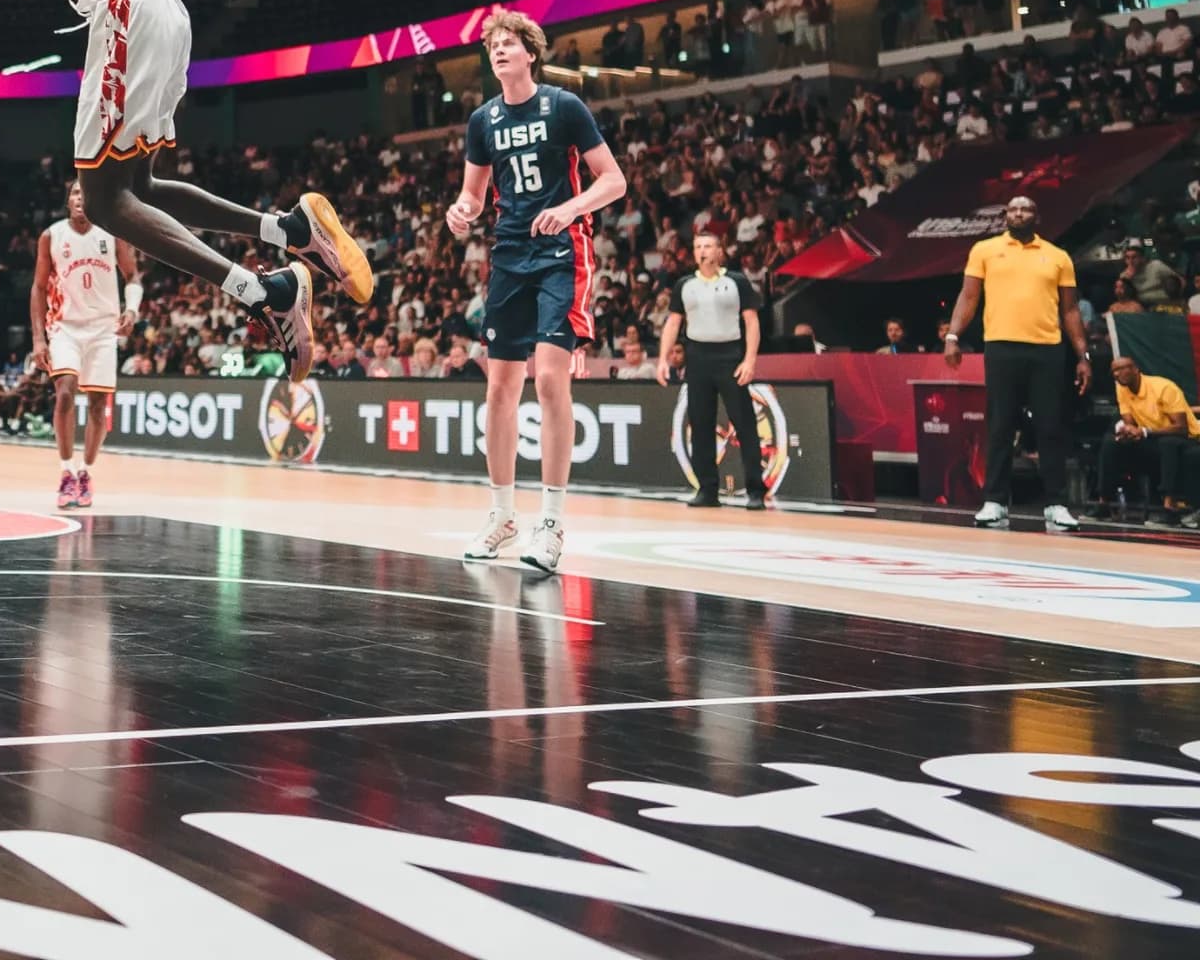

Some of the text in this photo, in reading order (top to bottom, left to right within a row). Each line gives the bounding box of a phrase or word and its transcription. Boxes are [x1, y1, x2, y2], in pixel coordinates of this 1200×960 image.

[493, 120, 548, 151] USA
[510, 152, 543, 194] 15
[83, 272, 92, 290] 0
[115, 391, 243, 440] TISSOT
[358, 404, 384, 444] T
